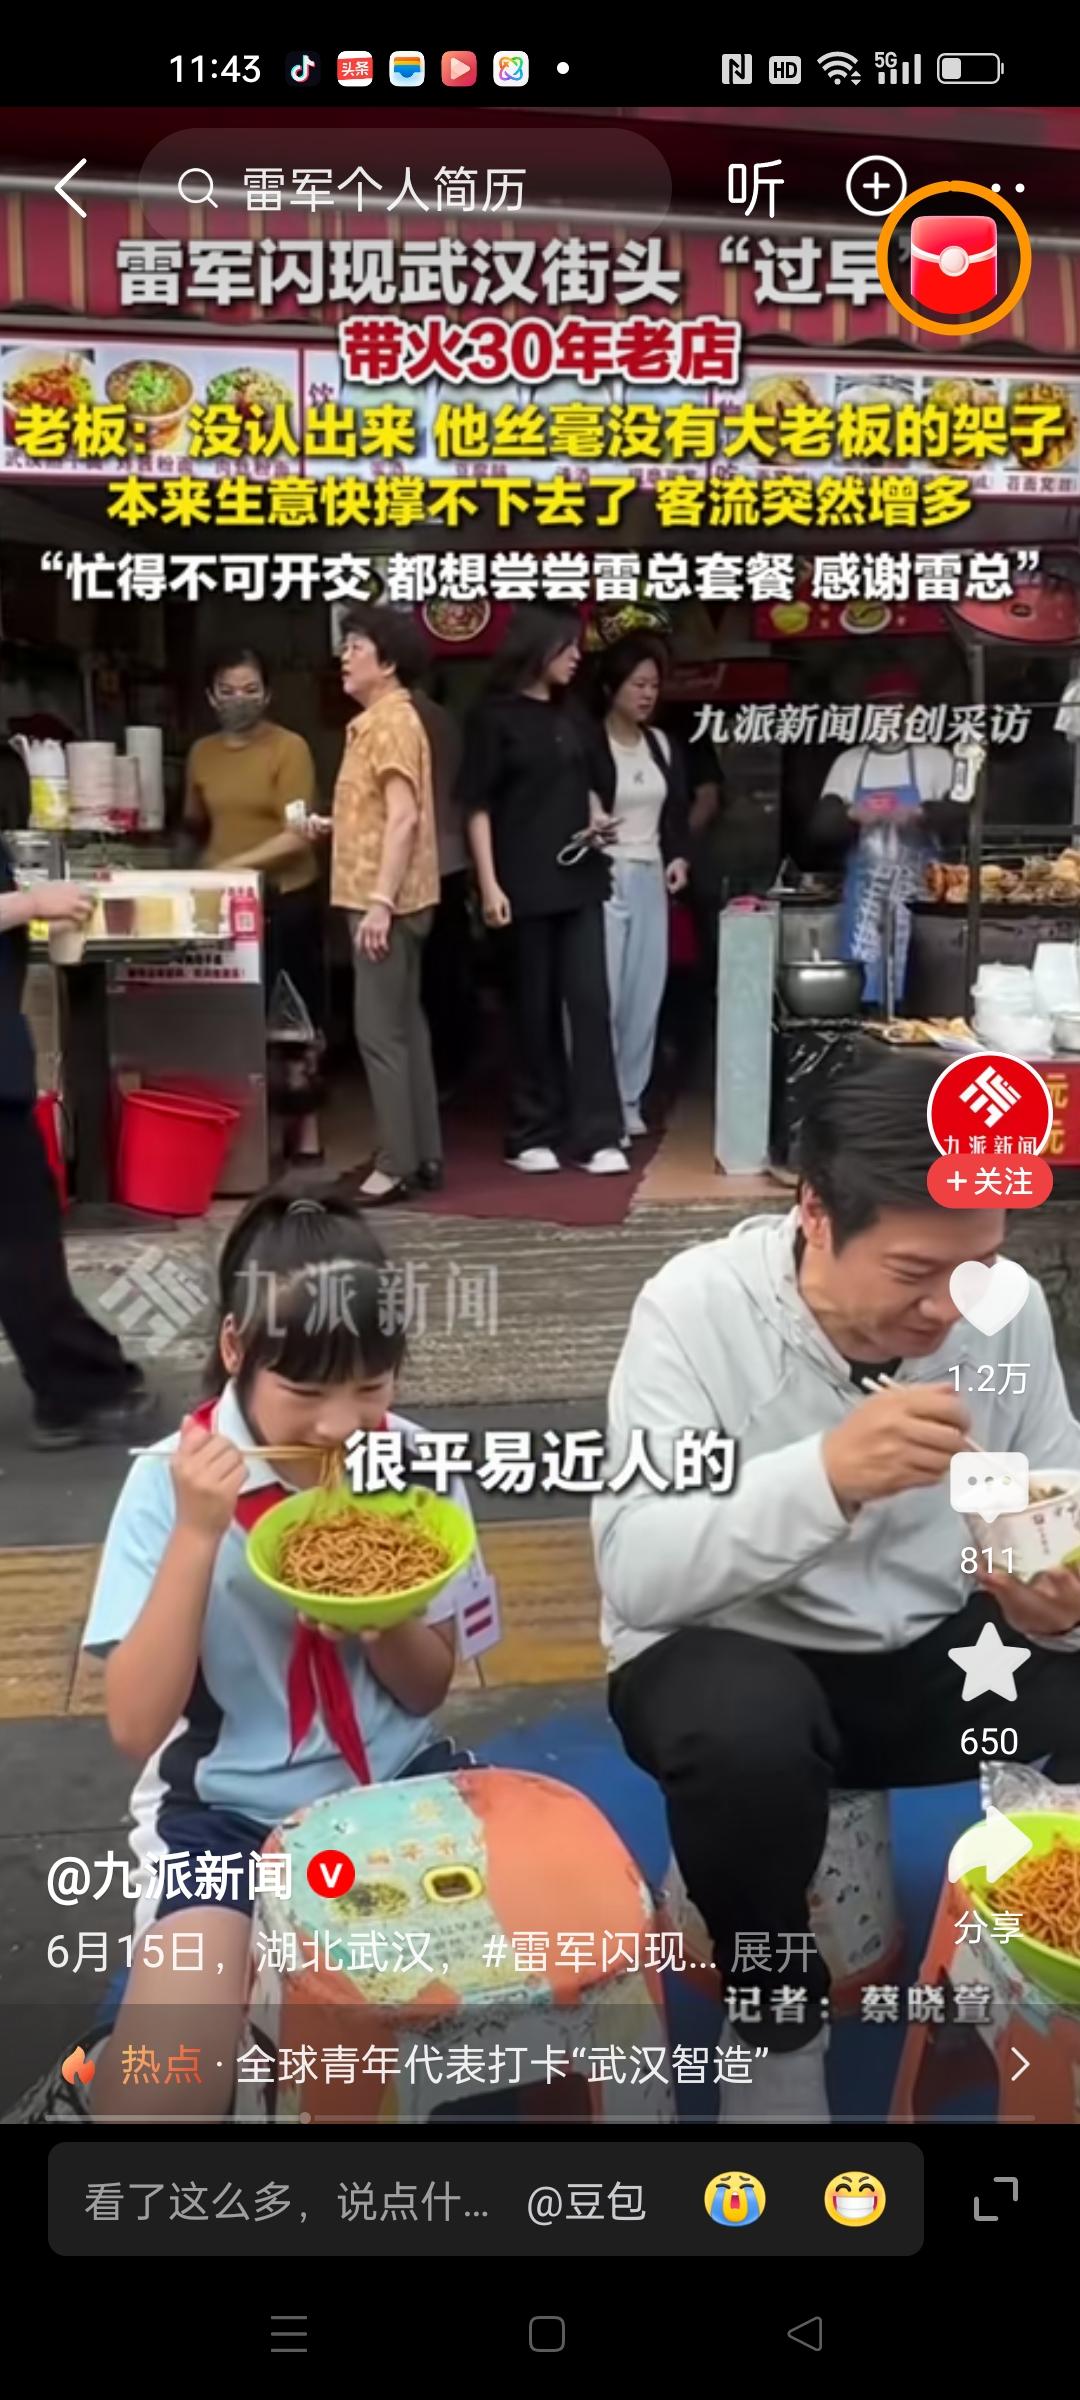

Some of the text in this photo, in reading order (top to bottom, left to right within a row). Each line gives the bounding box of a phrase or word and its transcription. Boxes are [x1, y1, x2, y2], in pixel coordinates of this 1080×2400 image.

[170, 55, 261, 83] 11:43
[341, 61, 370, 77] 头条
[773, 61, 798, 79] HD
[874, 51, 898, 69] 5G
[243, 166, 527, 213] 雷军个人简历
[728, 159, 785, 219] 听
[947, 1362, 1032, 1396] 1.2万
[960, 1546, 1014, 1574] 811
[960, 1727, 1019, 1755] 650
[47, 1850, 292, 1904] @九派新闻
[953, 1911, 1024, 1945] 分享
[731, 1932, 818, 1973] 展开
[121, 2044, 769, 2085] 热点 全球青年代表打卡“武汉智造”
[527, 2180, 646, 2226] @豆包
